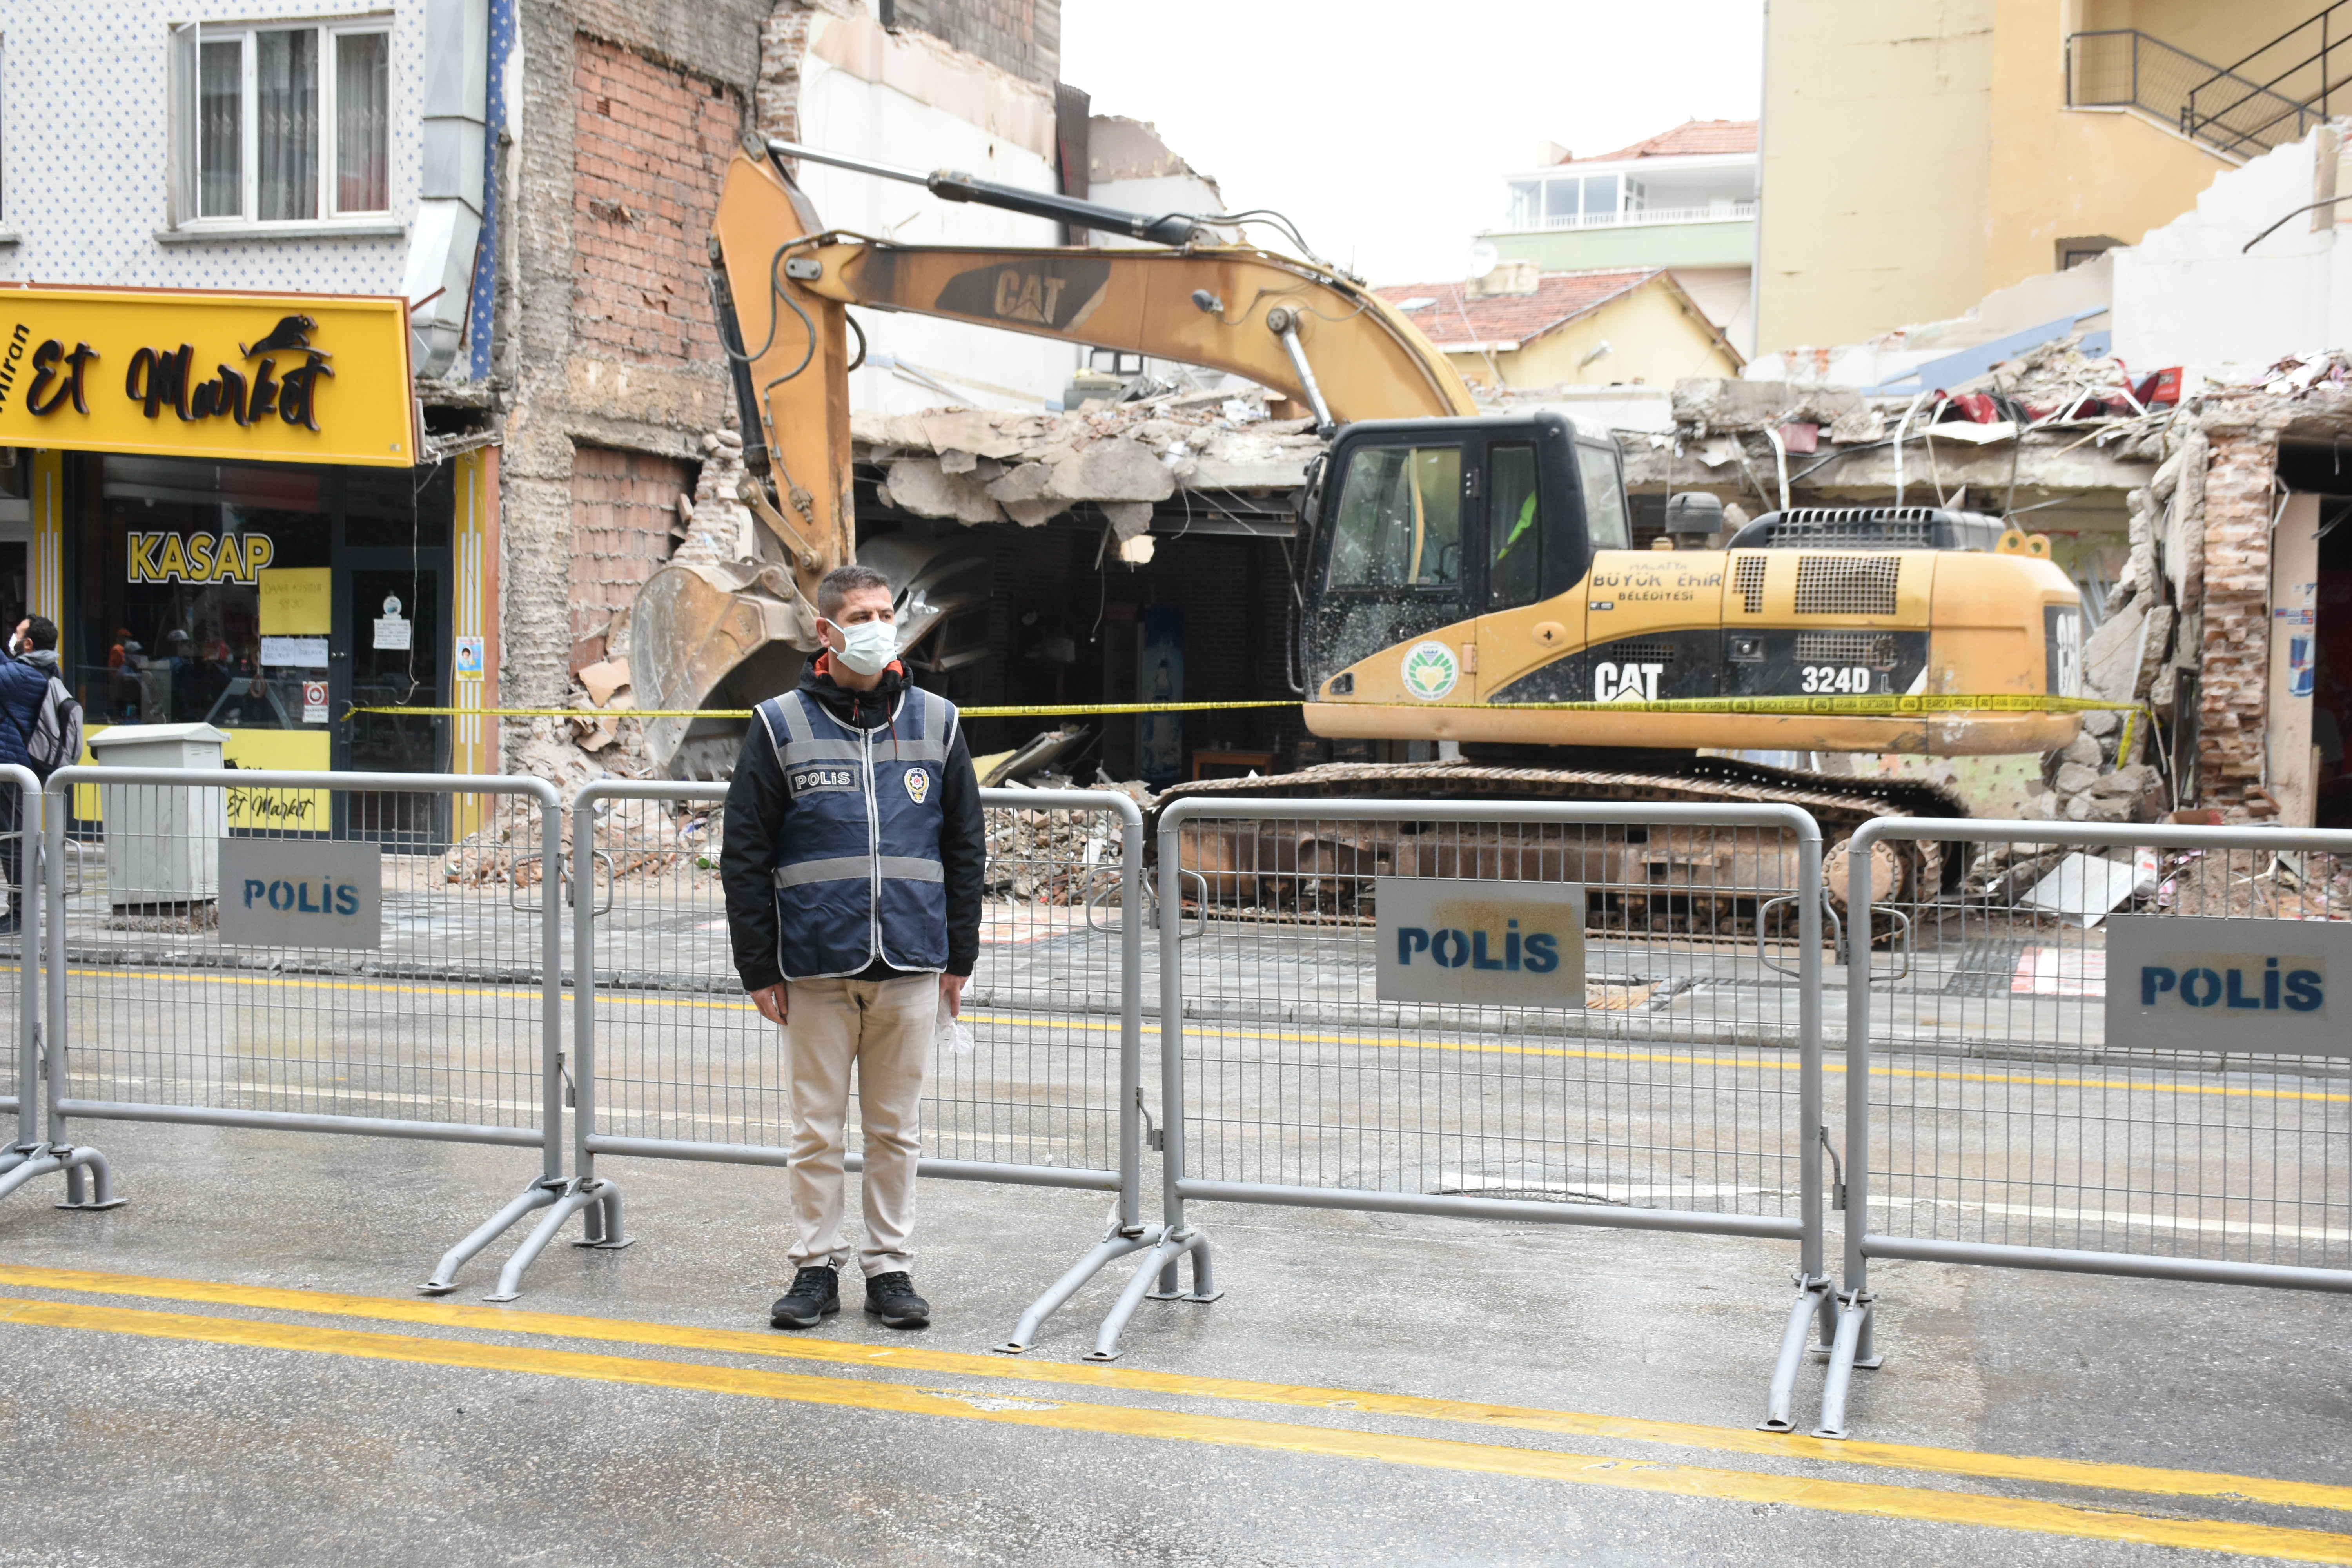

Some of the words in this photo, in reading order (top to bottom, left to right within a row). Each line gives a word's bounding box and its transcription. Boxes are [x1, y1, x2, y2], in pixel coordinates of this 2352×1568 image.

[995, 270, 1065, 325] CAT
[26, 339, 100, 416] Et
[126, 343, 335, 431] Market
[127, 531, 274, 585] KASAP
[1595, 662, 1663, 702] CAT
[1802, 666, 1869, 693] 324D
[252, 795, 314, 820] Market
